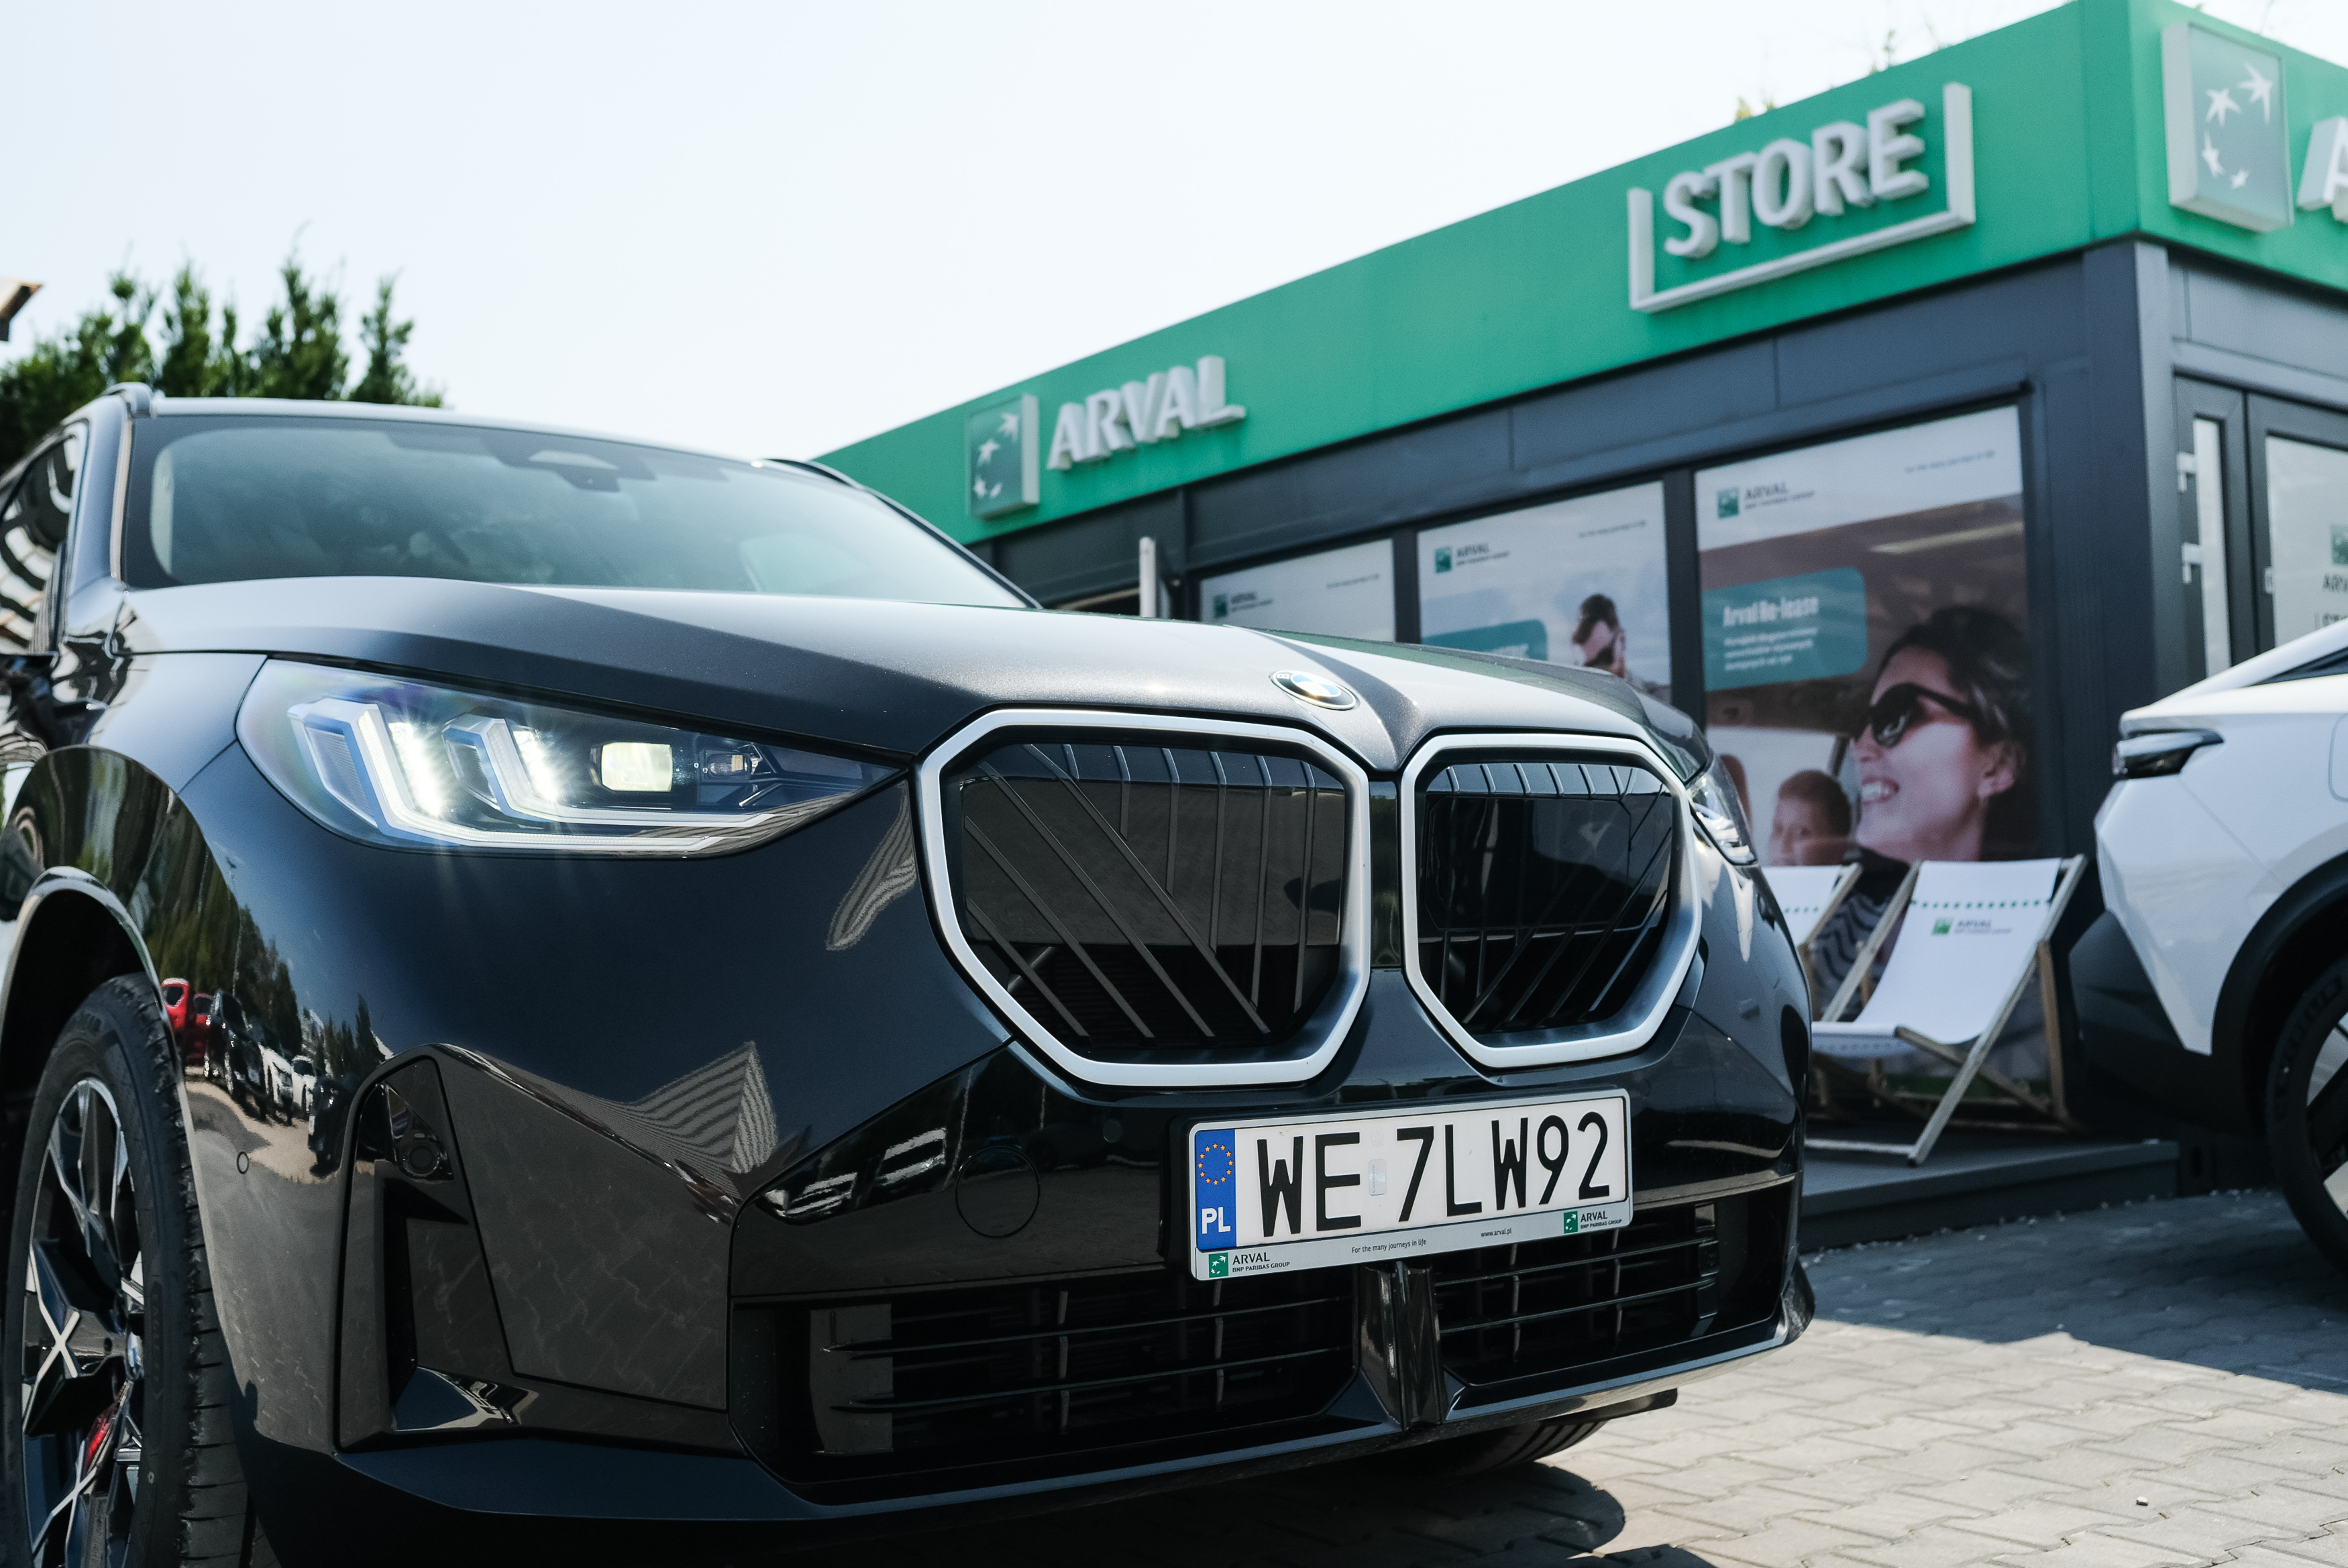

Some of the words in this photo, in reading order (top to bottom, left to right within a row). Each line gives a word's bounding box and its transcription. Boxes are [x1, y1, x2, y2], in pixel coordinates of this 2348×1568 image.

[1664, 98, 1929, 258] STORE
[1047, 355, 1246, 470] ARVAL
[1257, 1132, 1361, 1237] WE
[1397, 1111, 1610, 1223] 7LW92
[1202, 1207, 1231, 1235] PL
[1581, 1211, 1607, 1222] ARVAL
[1481, 1227, 1512, 1237] www.arval.pl
[1388, 1242, 1411, 1251] journeys
[1418, 1239, 1426, 1247] life
[1232, 1252, 1270, 1265] ARVAL
[1245, 1264, 1269, 1272] PARIBAS
